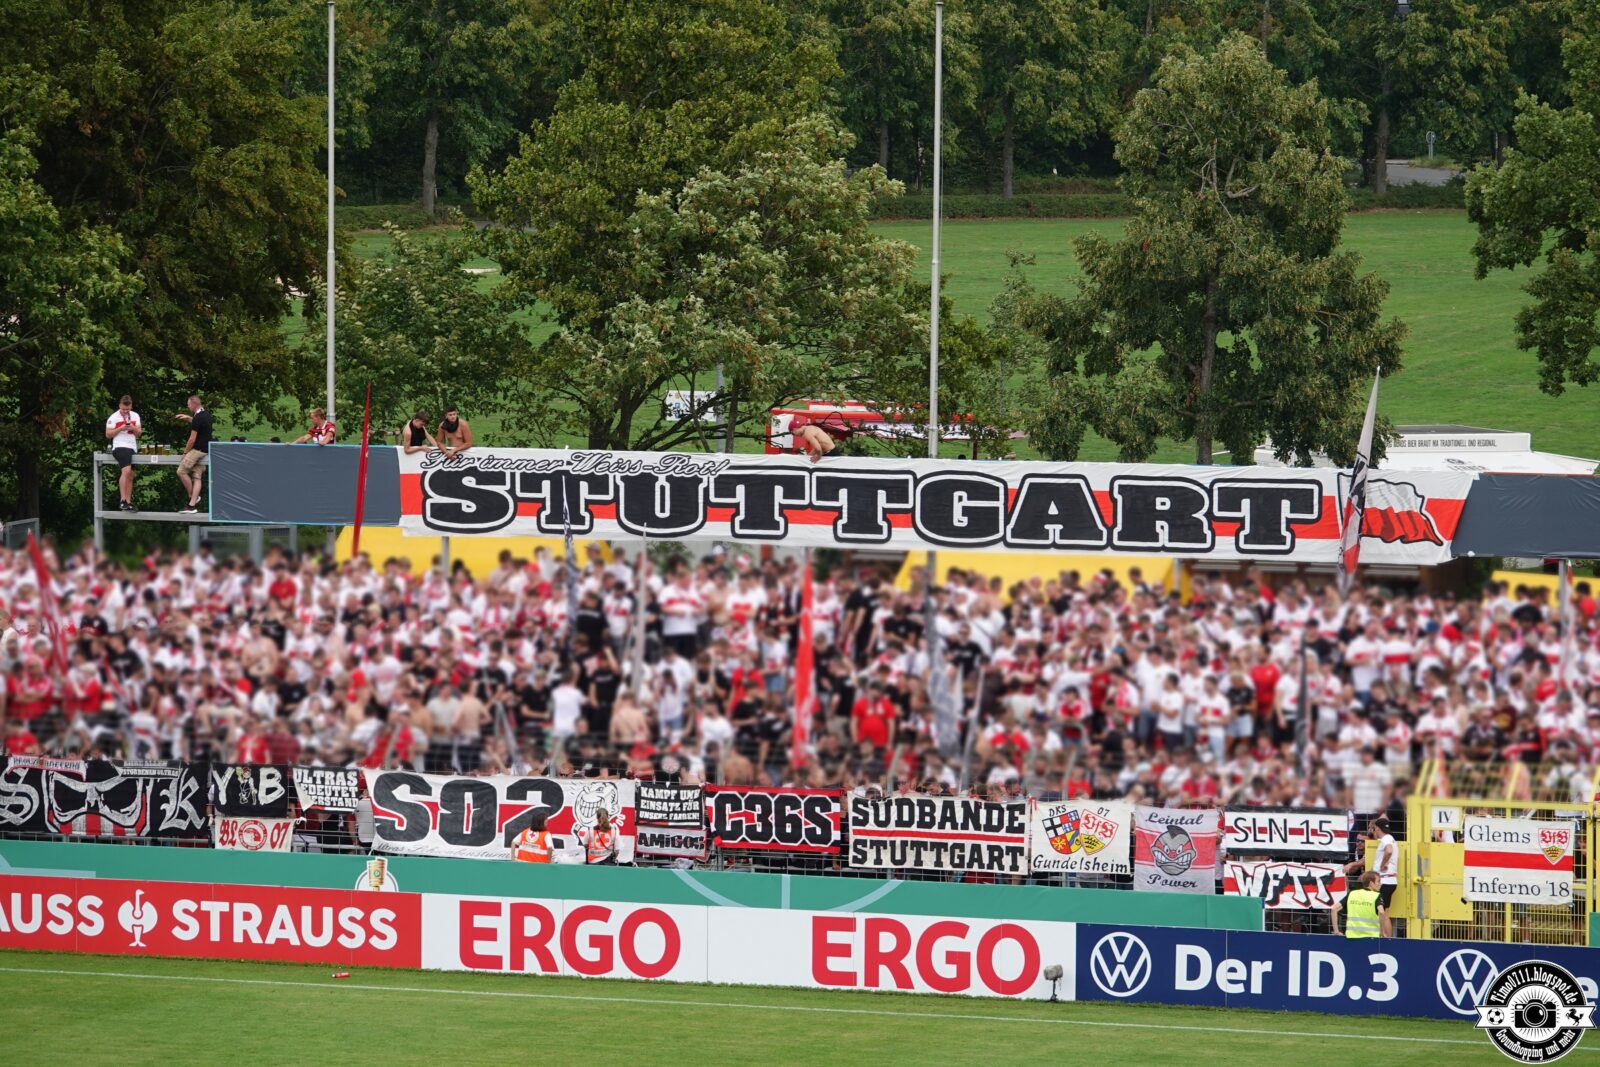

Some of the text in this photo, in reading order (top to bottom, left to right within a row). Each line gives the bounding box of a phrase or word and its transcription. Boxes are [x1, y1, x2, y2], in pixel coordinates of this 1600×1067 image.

[479, 454, 564, 473] immer
[421, 466, 1322, 554] STUTTGART
[293, 768, 358, 787] ULTRAS
[640, 786, 677, 800] KAMPF
[640, 799, 699, 812] EINSATZ FÜR
[1049, 804, 1111, 817] DKS 07
[1145, 811, 1204, 826] Leintal
[1234, 816, 1334, 846] SLN 15
[1469, 824, 1531, 844] Glems
[851, 838, 1024, 872] STUTTGART
[1033, 854, 1128, 874] Gundelsheim
[1147, 873, 1199, 889] Power
[1469, 876, 1541, 897] Inferno
[171, 899, 398, 951] STRAUSS
[459, 900, 681, 978] ERGO
[812, 915, 1041, 995] ERGO
[1175, 944, 1272, 994] Der
[1288, 949, 1399, 1002] ID.3
